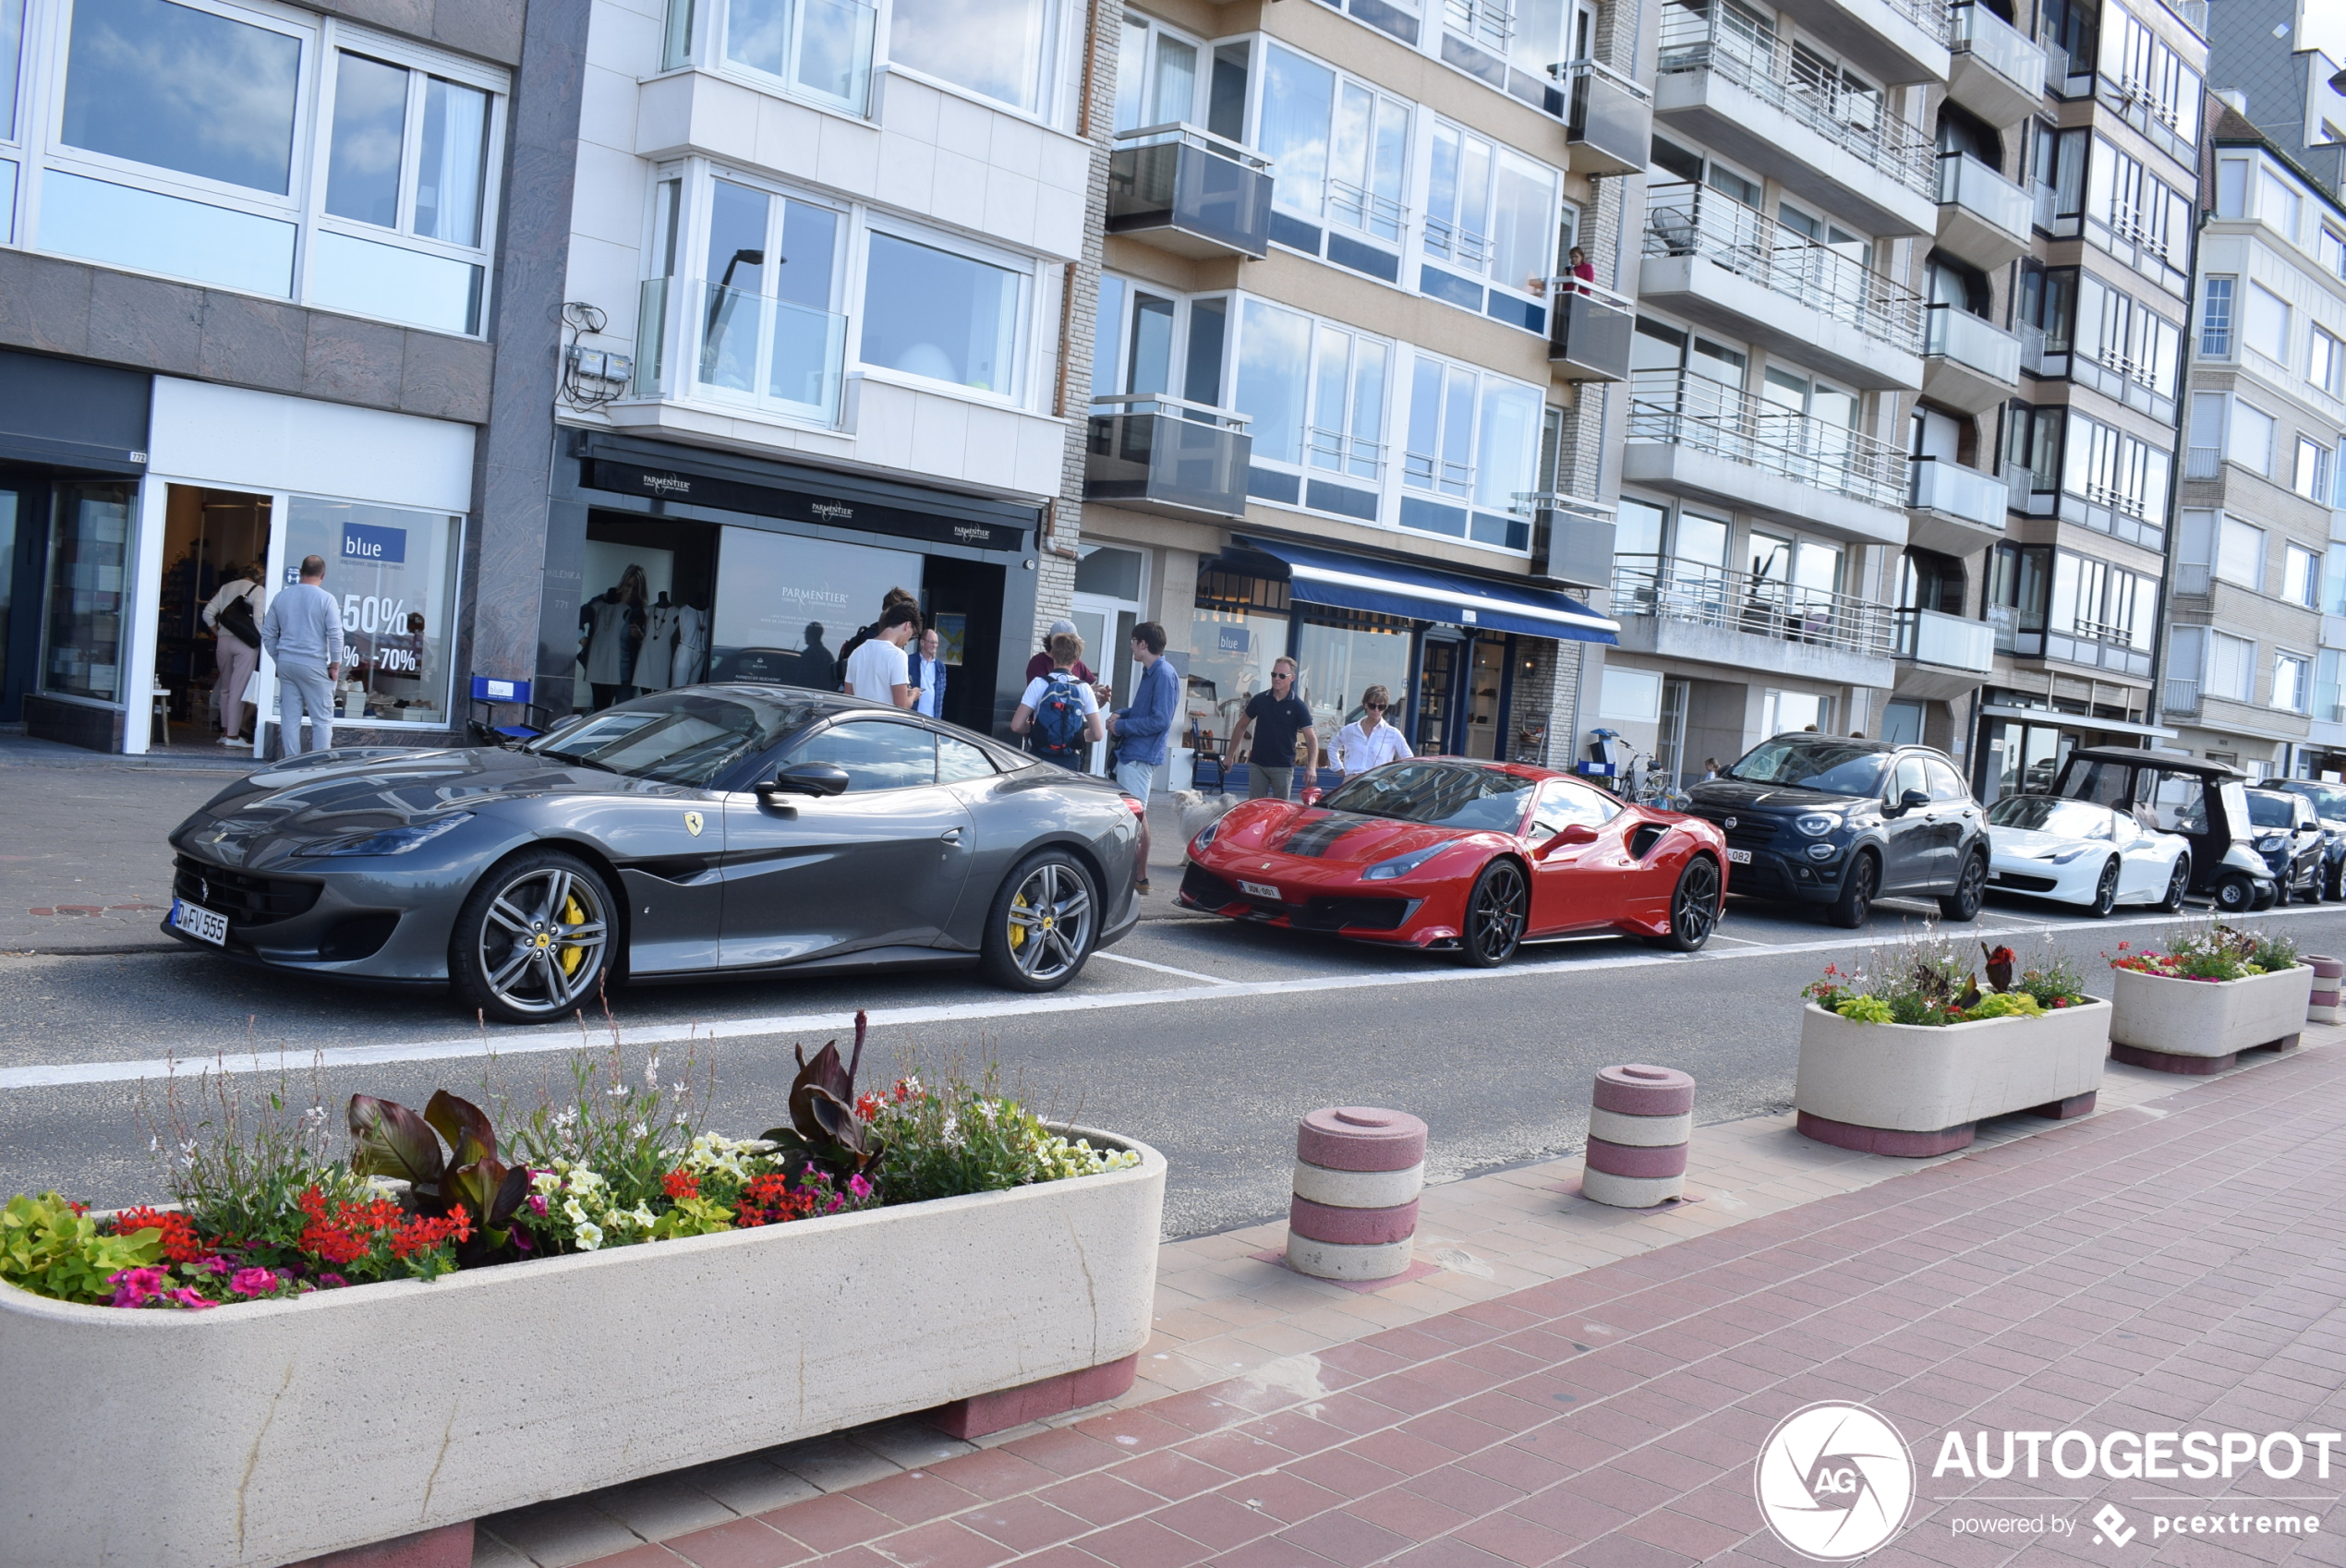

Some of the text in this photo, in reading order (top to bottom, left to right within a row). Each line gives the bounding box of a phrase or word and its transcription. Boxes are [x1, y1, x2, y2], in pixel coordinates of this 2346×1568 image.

[132, 452, 146, 462] 772
[345, 536, 382, 557] blue
[555, 599, 568, 609] 771
[1220, 635, 1238, 649] blue
[372, 648, 416, 671] -70%
[490, 686, 504, 694] blue
